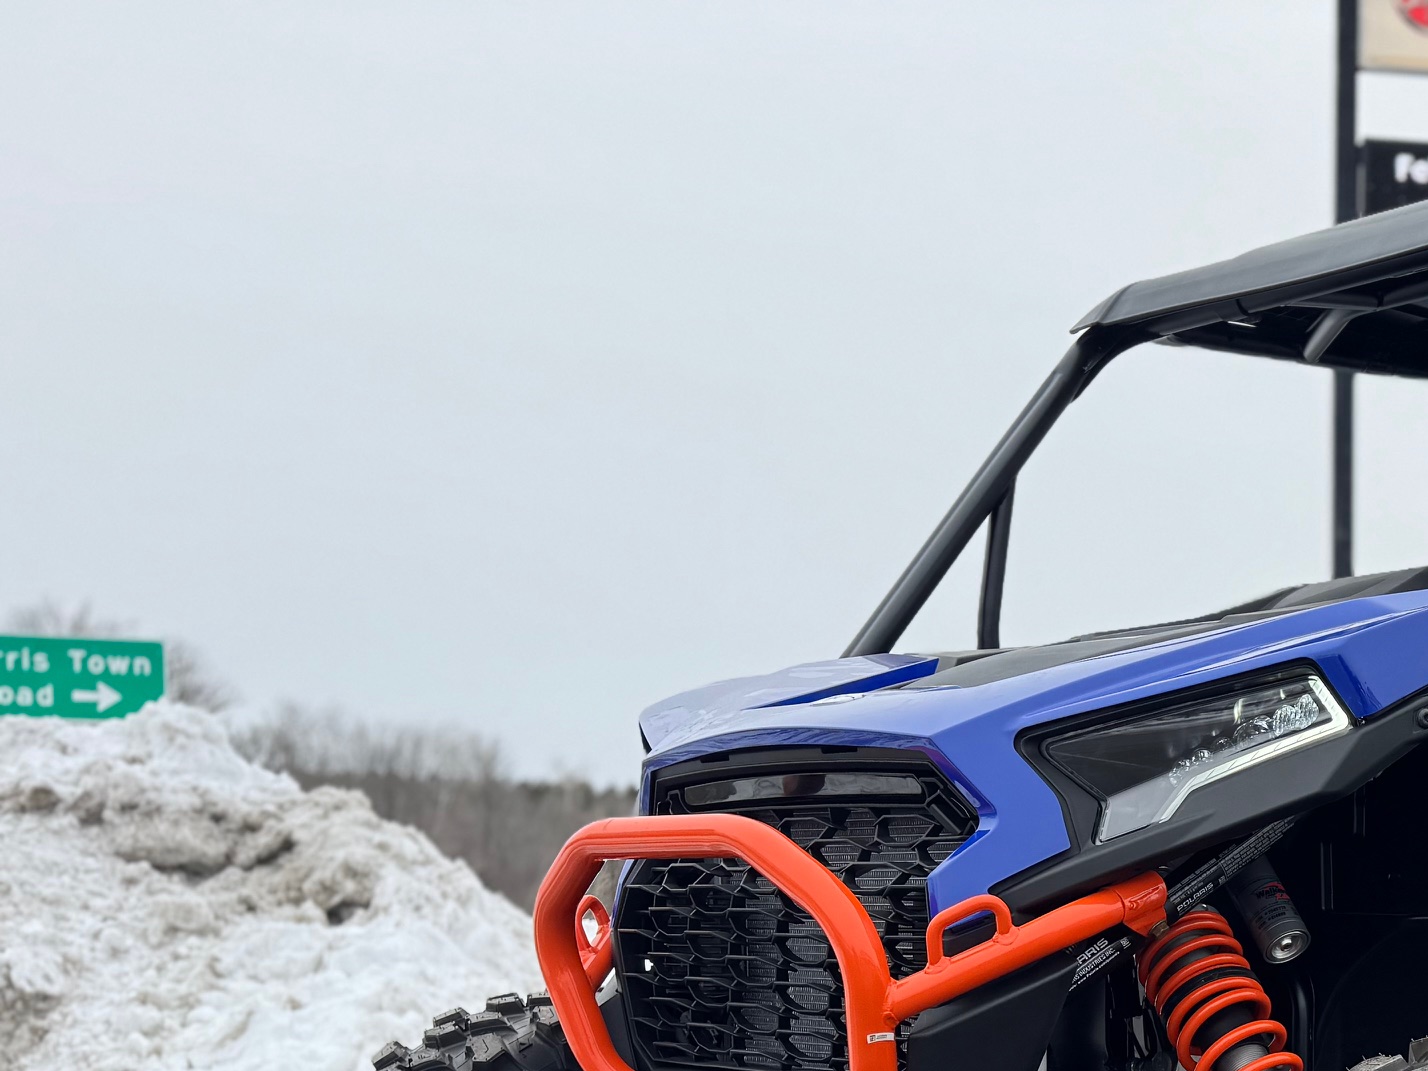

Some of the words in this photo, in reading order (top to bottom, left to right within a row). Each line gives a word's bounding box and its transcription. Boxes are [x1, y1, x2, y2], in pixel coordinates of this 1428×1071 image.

[0, 646, 50, 674] ris
[67, 648, 152, 677] Town
[1176, 882, 1214, 912] POLARIS
[1076, 937, 1109, 966] ARIS
